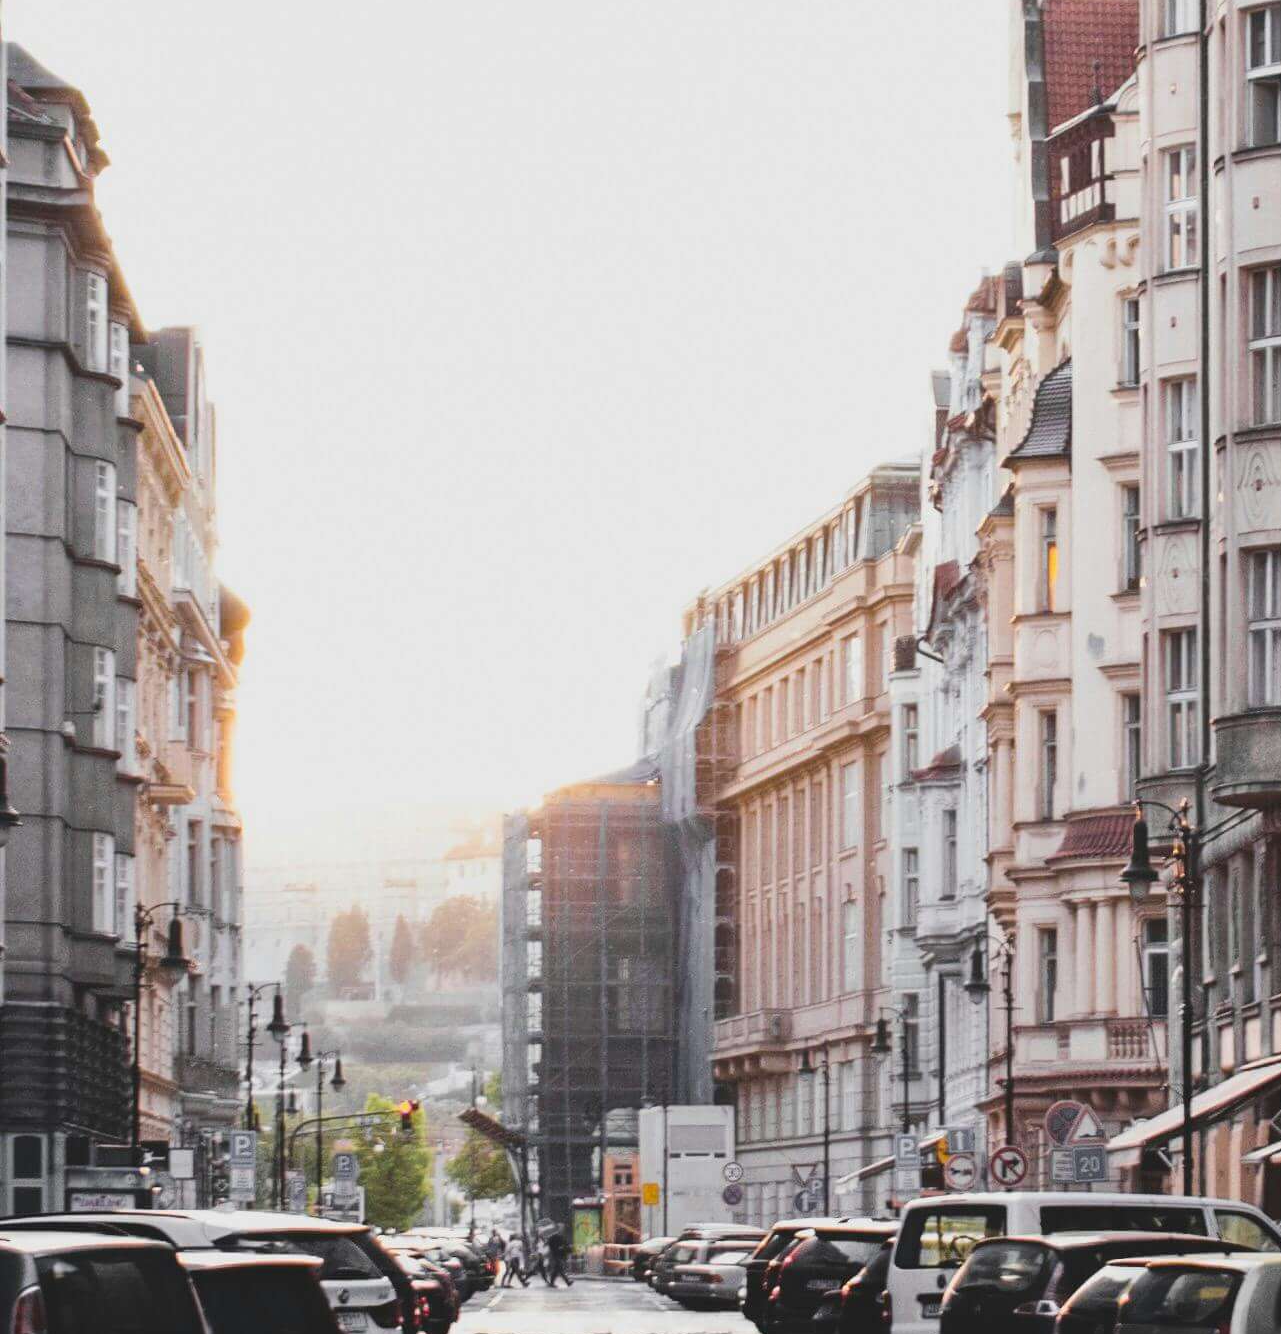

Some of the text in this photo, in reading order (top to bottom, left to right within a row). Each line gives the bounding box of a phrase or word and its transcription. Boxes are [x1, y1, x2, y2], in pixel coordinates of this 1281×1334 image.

[234, 1137, 251, 1155] P
[902, 1140, 914, 1156] P
[1080, 1157, 1099, 1173] 20
